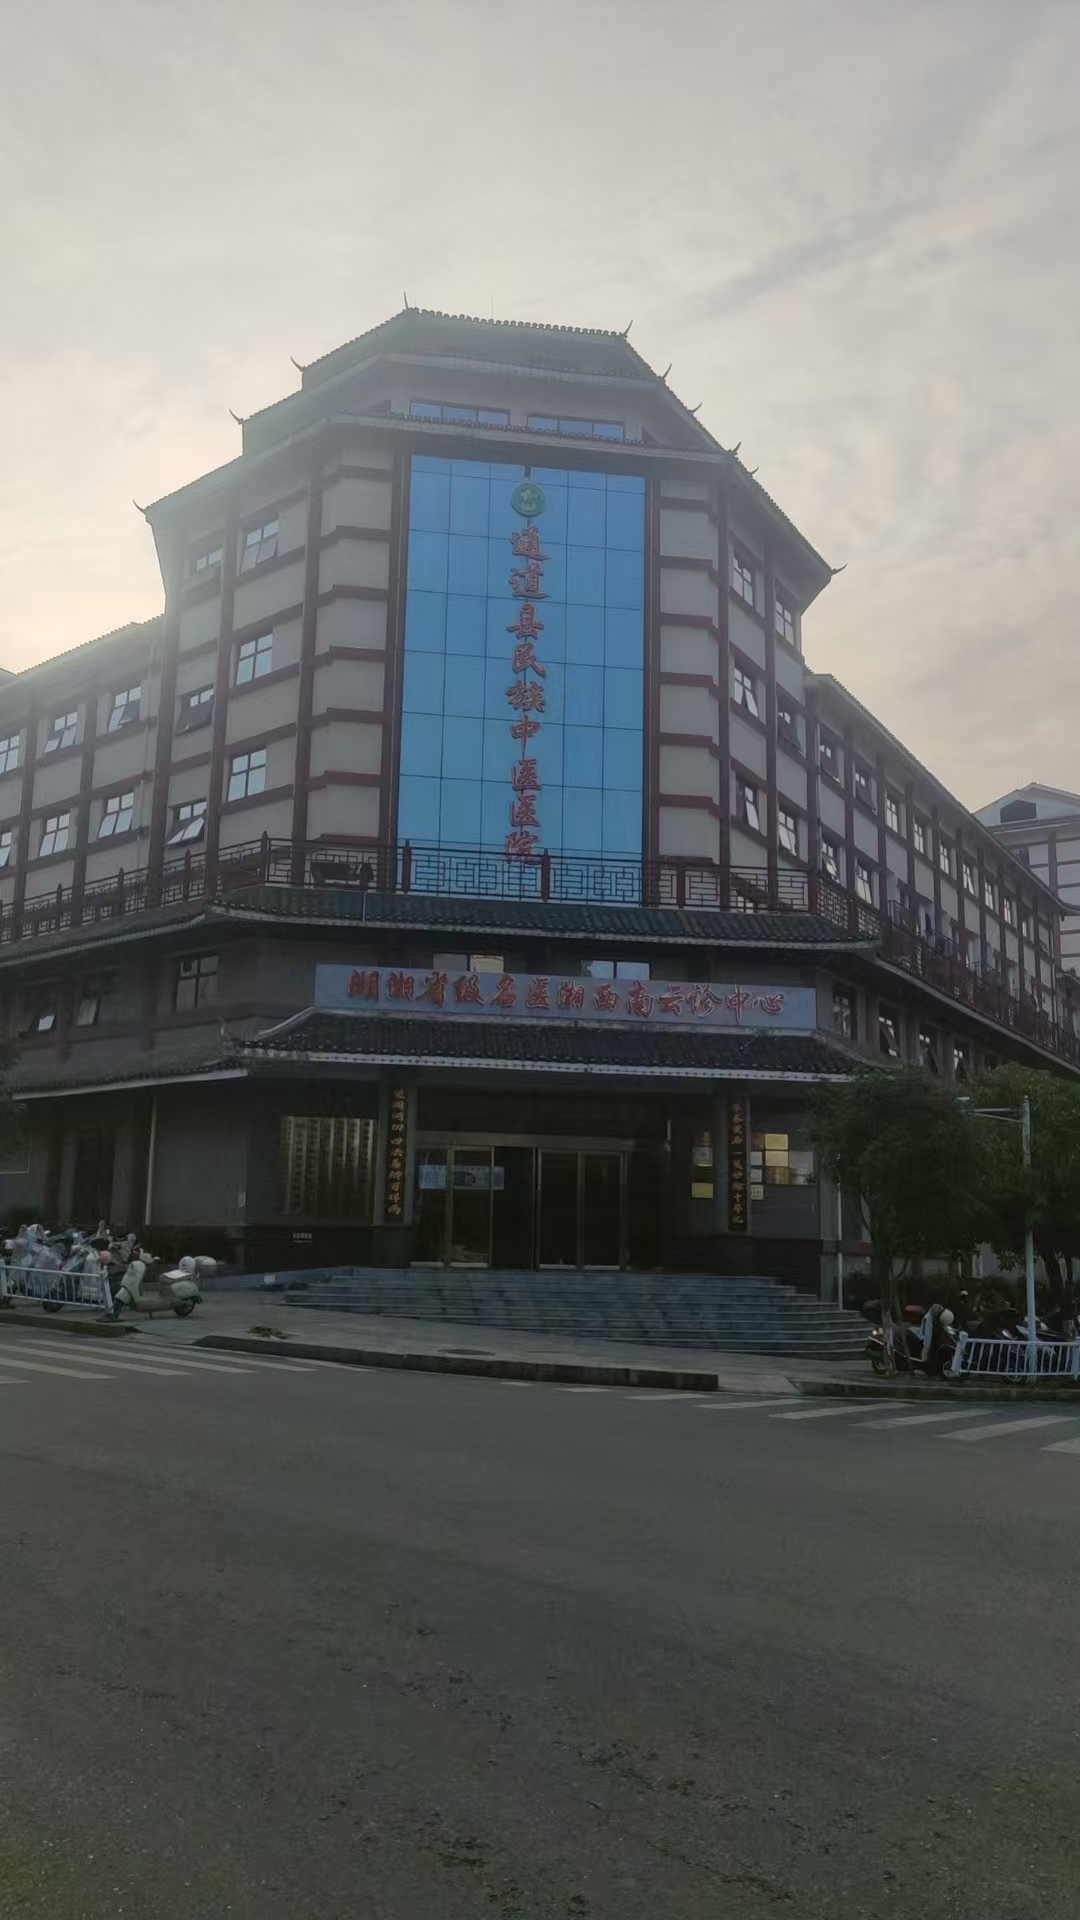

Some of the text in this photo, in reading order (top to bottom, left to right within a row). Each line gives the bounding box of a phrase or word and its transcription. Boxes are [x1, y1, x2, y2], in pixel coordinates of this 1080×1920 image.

[505, 523, 550, 864] 通道县民族中医医院
